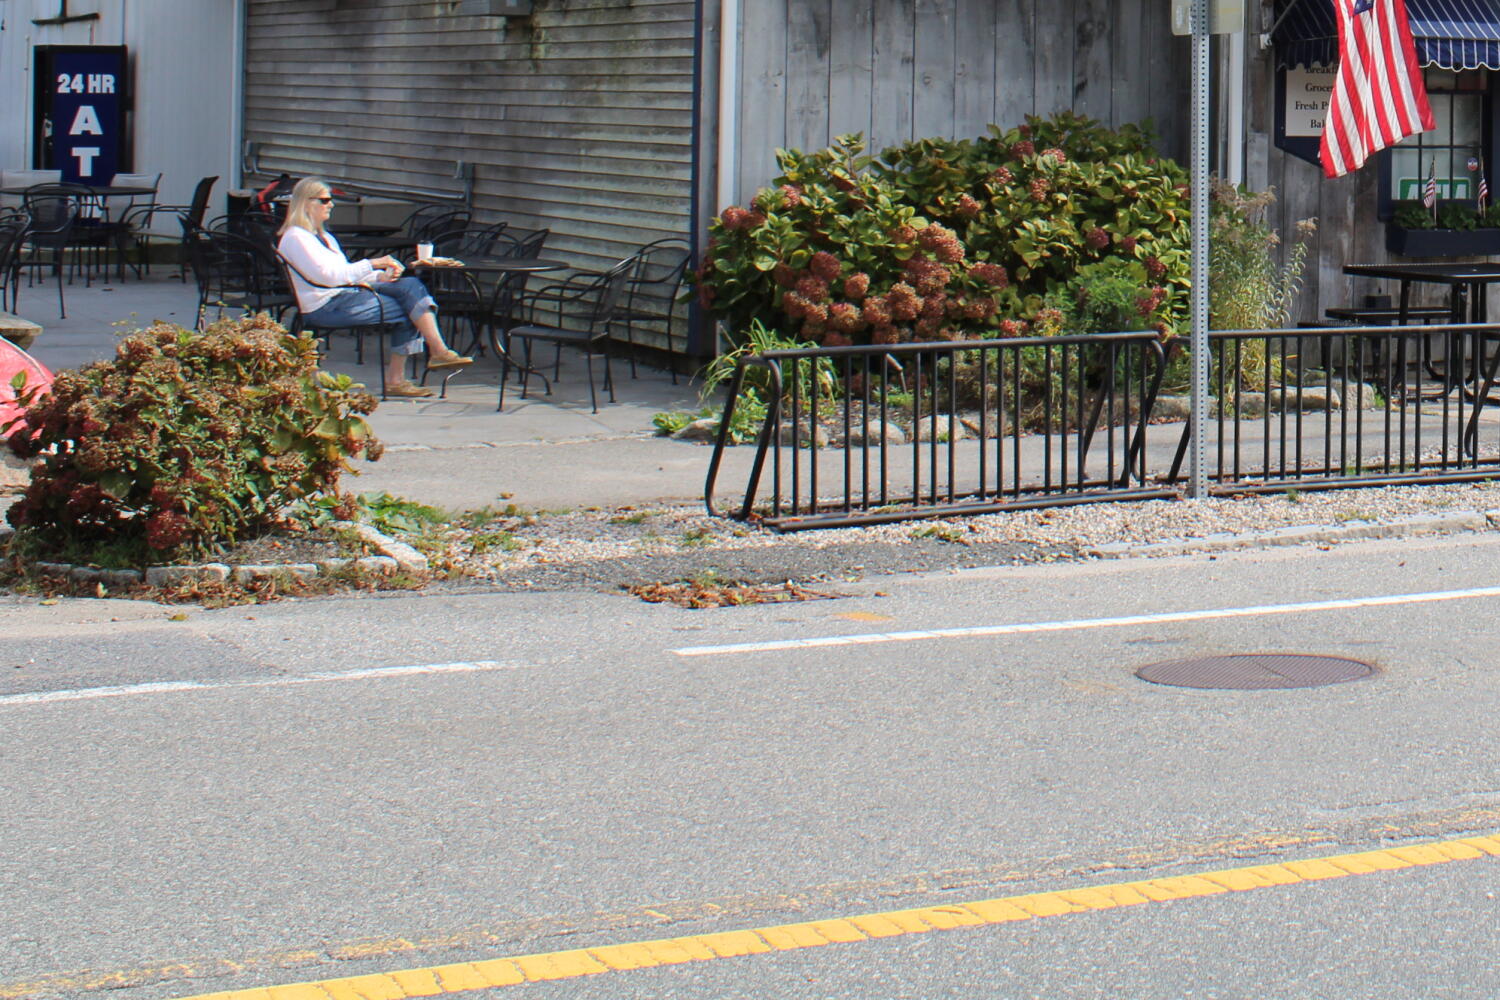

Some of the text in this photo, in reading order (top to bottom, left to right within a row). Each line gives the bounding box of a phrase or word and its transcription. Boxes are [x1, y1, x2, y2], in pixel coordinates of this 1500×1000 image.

[57, 73, 115, 94] 24 HR
[1295, 101, 1318, 110] Fresh
